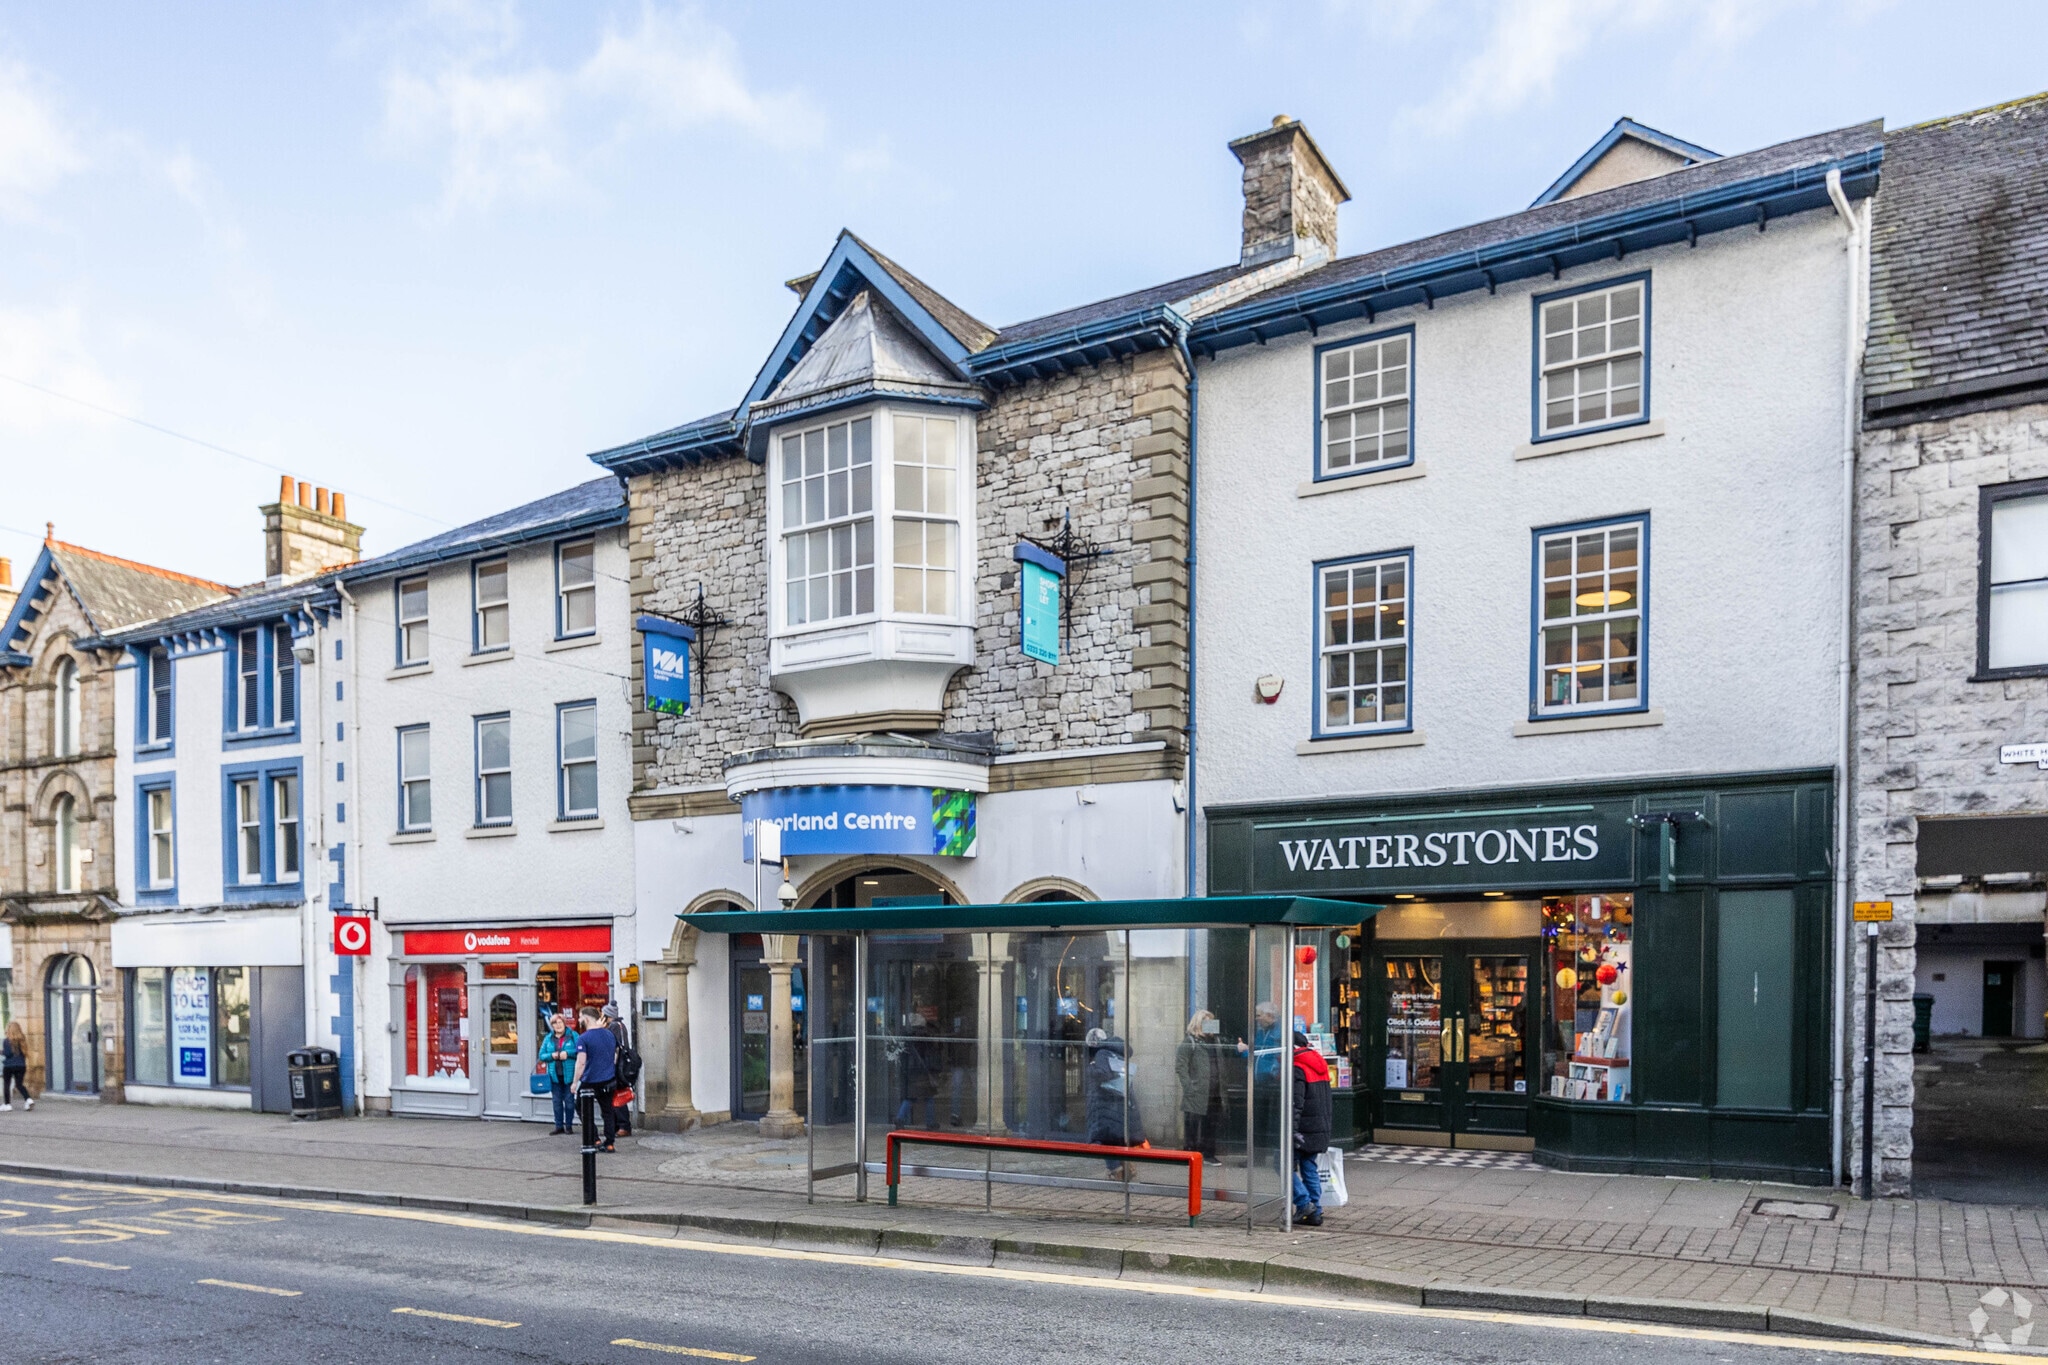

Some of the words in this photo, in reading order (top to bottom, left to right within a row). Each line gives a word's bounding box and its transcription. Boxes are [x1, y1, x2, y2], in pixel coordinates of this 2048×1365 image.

[2003, 749, 2035, 757] WHITE
[843, 811, 916, 830] Centre
[1279, 824, 1599, 872] WATERSTONES
[477, 935, 510, 946] vodafone
[520, 937, 539, 945] Kendal
[176, 976, 206, 991] SHOP
[173, 994, 188, 1008] TO
[191, 994, 209, 1008] LET
[1387, 1018, 1406, 1026] Click
[1414, 1018, 1441, 1026] Collect
